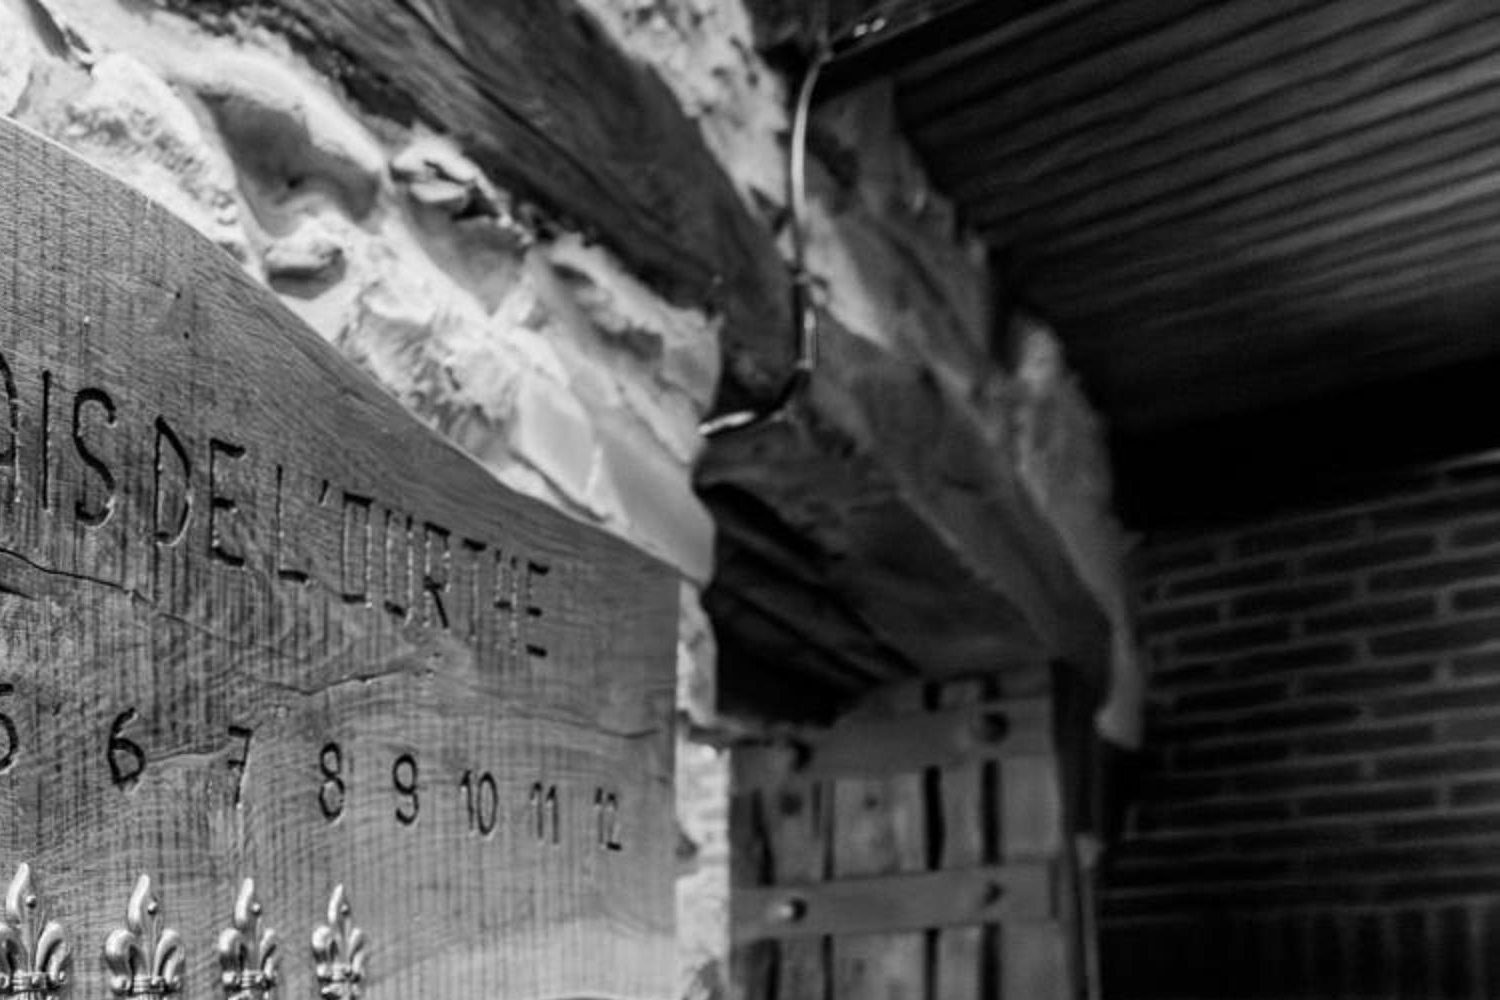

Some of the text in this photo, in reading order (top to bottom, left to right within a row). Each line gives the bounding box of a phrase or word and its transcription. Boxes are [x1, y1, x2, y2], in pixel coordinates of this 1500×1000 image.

[152, 413, 247, 567] DE
[105, 707, 147, 793] 6
[226, 725, 254, 808] 7
[318, 740, 347, 823] 8
[393, 752, 421, 826] 9
[459, 767, 498, 838] 10
[528, 781, 560, 845] 11
[592, 786, 623, 851] 12
